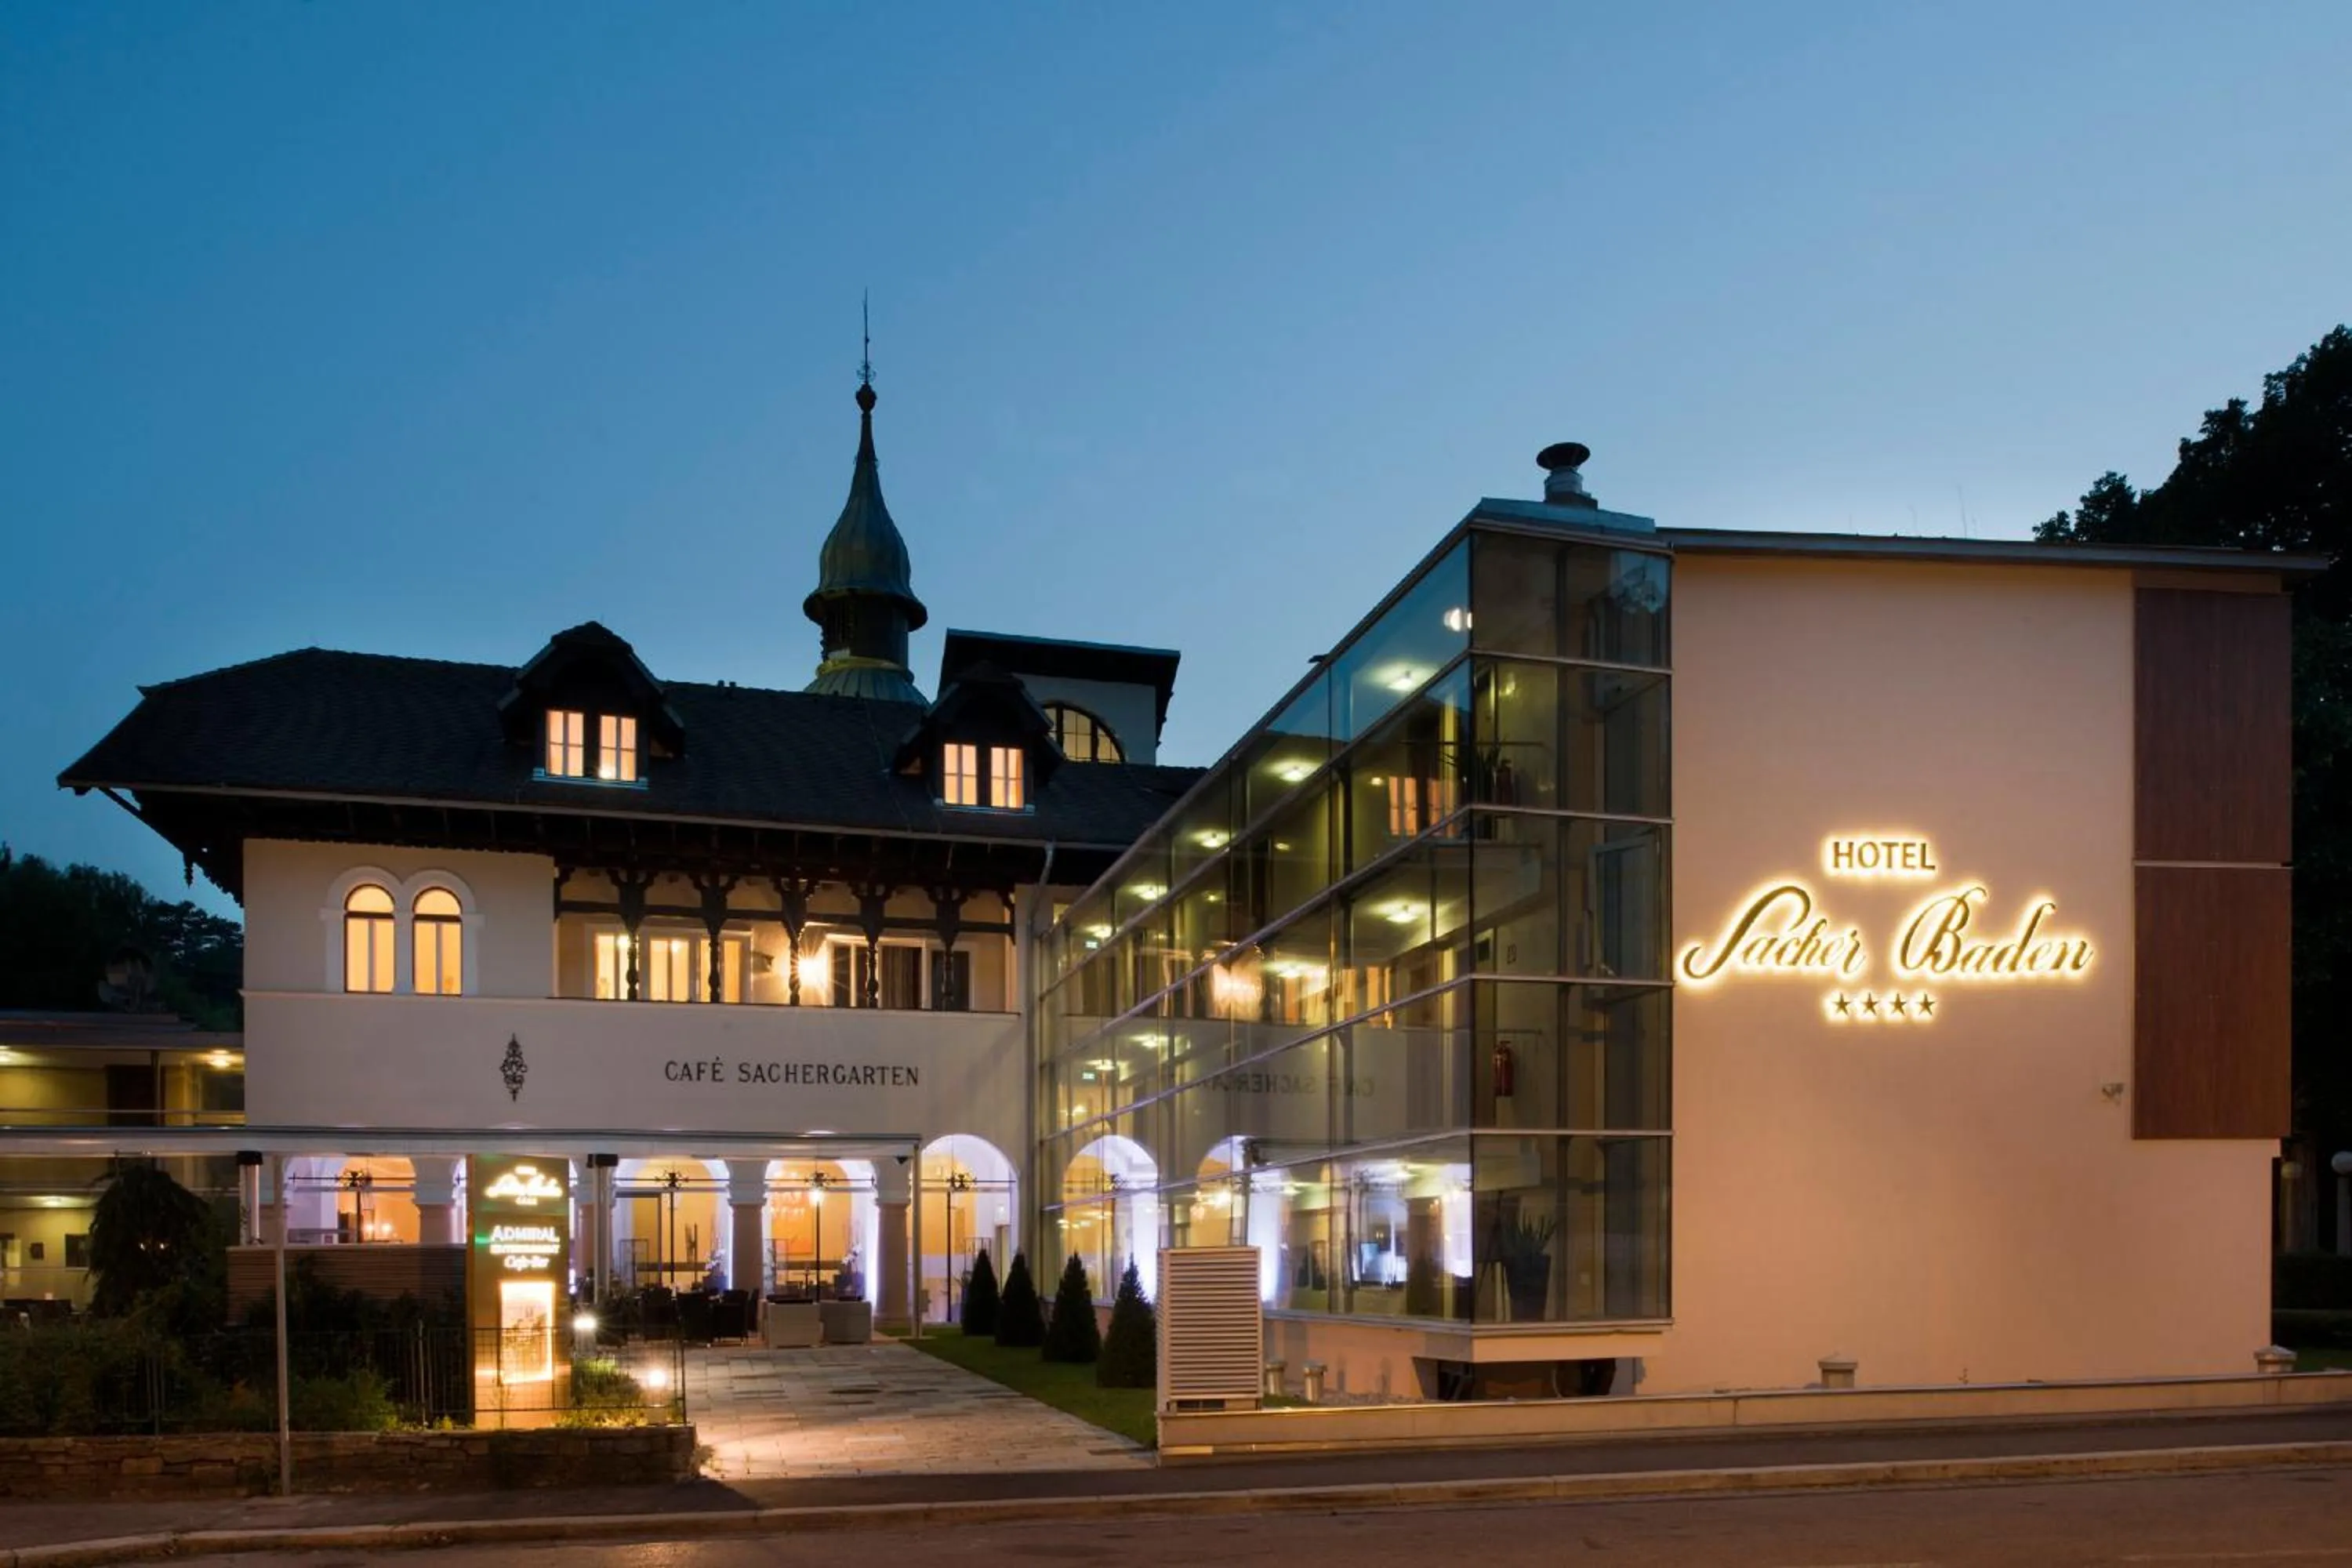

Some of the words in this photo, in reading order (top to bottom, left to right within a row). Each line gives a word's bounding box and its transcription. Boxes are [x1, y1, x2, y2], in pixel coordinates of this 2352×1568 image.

[1832, 840, 1936, 871] HOTEL
[1683, 885, 1866, 979] Sacher
[1900, 886, 2095, 975] Baden
[665, 1056, 724, 1082] CAFÉ
[738, 1062, 919, 1087] SACHERGARTEN
[490, 1225, 561, 1243] ADMIRAL
